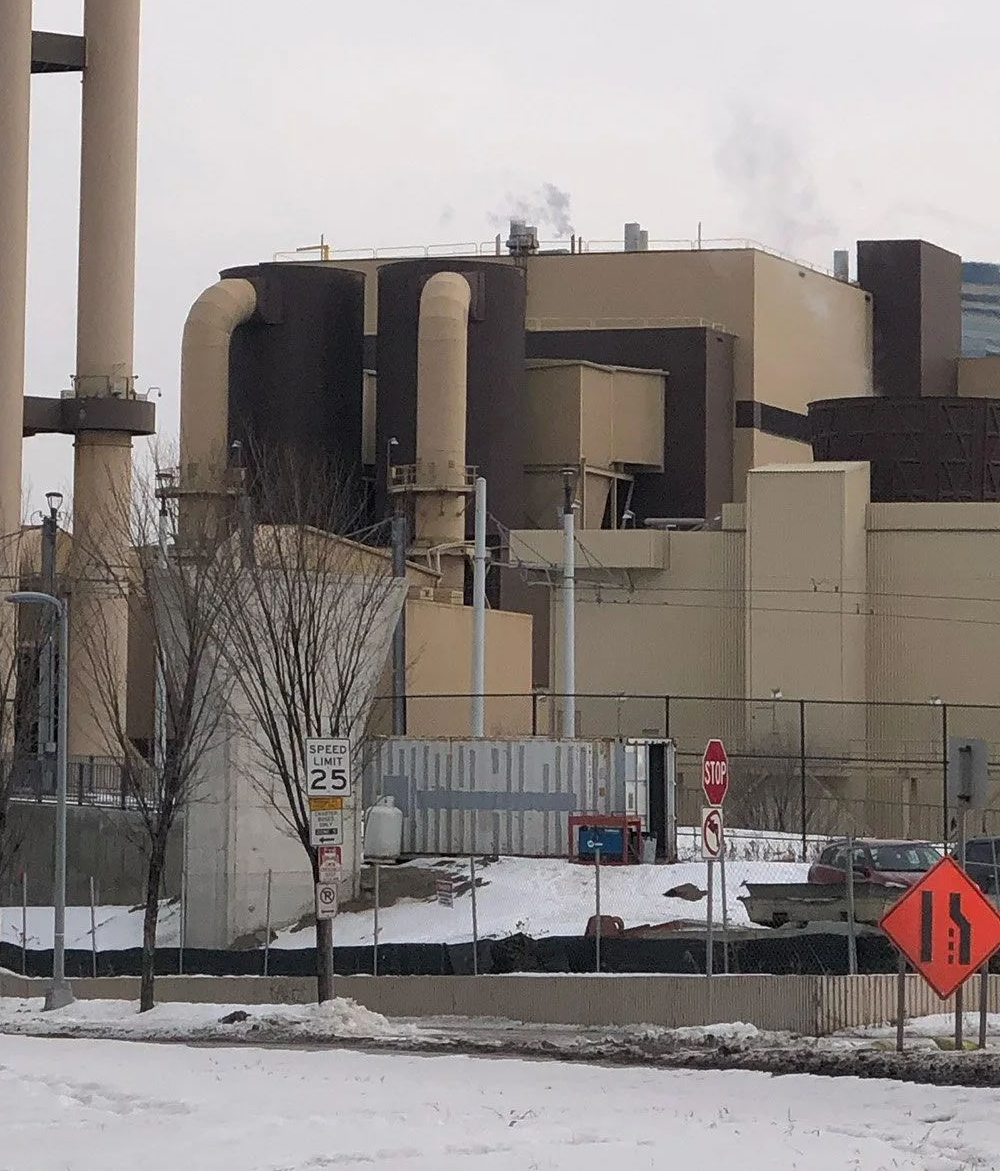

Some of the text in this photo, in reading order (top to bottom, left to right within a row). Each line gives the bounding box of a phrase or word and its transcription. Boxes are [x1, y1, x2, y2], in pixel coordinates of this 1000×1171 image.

[309, 745, 347, 754] SPEED
[313, 757, 343, 766] LIMIT
[310, 769, 347, 790] 25
[704, 761, 727, 785] STOP
